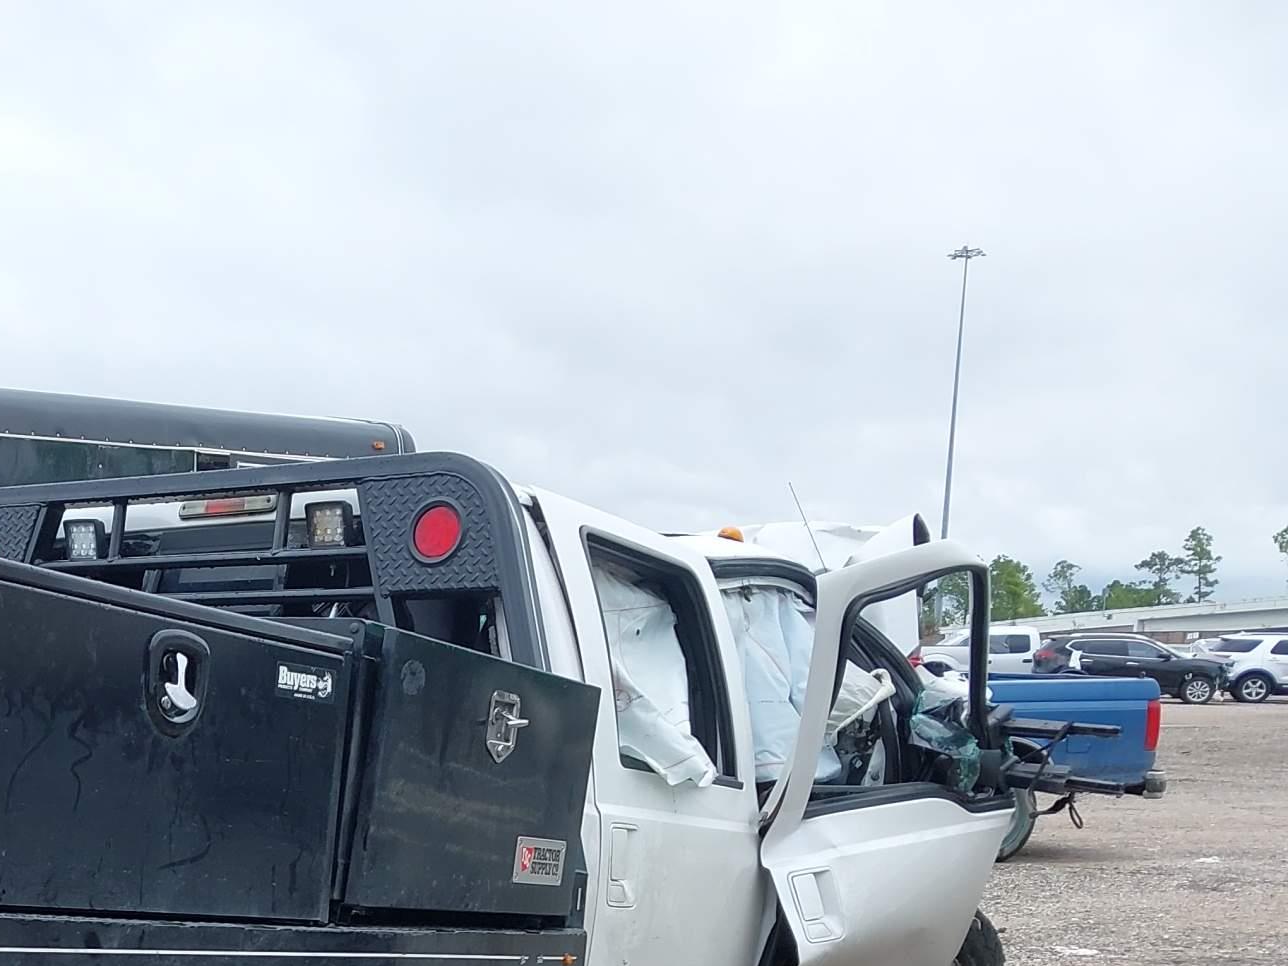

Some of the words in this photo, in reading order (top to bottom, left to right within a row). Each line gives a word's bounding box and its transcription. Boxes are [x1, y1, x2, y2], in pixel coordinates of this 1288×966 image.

[278, 665, 317, 690] Buyers
[533, 847, 561, 862] TRACTOR
[530, 861, 552, 875] SUPPLY
